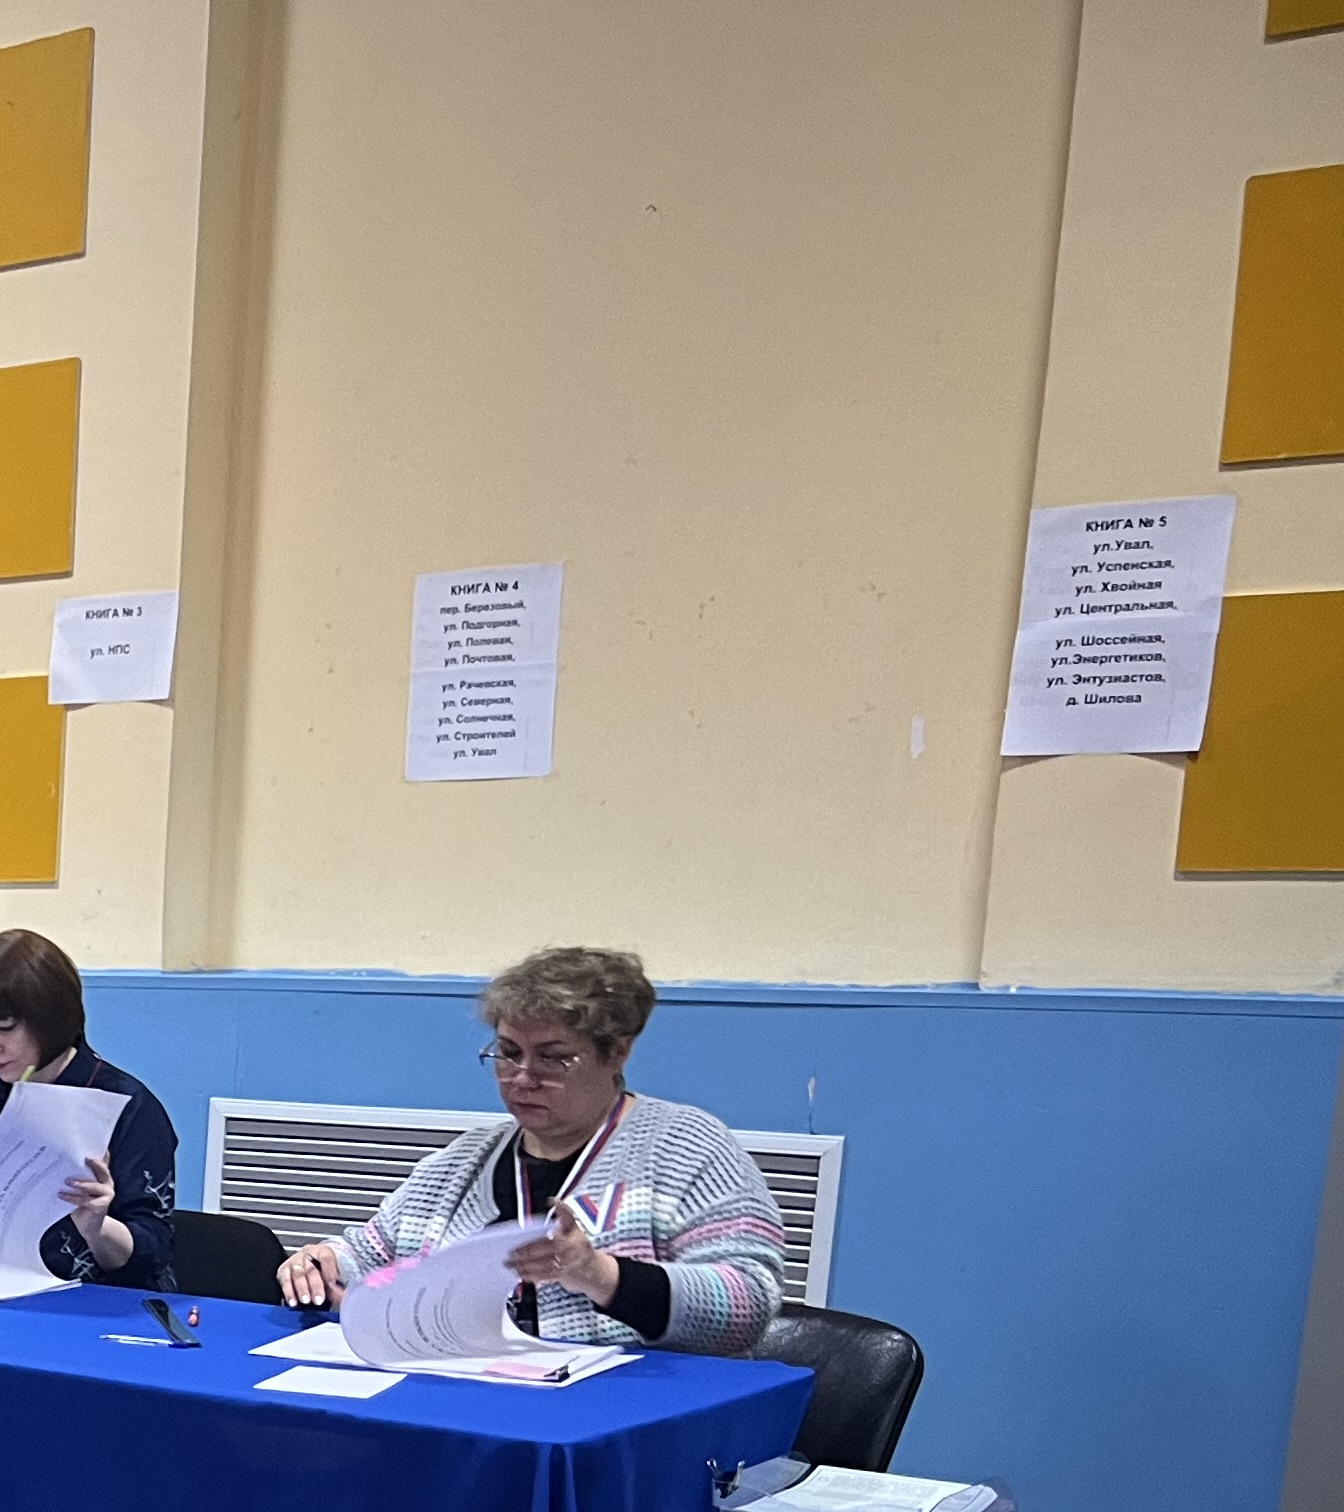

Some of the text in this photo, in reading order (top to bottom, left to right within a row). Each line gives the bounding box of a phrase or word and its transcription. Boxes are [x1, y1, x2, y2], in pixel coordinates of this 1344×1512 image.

[1085, 516, 1167, 532] КНИГА № 5
[1071, 559, 1174, 577] ул. Успенская,
[451, 581, 518, 595] КНИГА № 4
[1075, 580, 1161, 597] ул. Хвойная
[86, 606, 142, 620] КНИГА № 3
[440, 606, 460, 615] пер.
[1055, 600, 1177, 618] ул. Центральная,
[443, 623, 458, 633] ул.
[447, 640, 462, 649] ул.
[1055, 634, 1165, 650] ул. Шоссейная,
[108, 644, 130, 655] НПС
[444, 657, 459, 667] ул.
[1046, 673, 1166, 688] ул. Энтузиастов,
[441, 683, 456, 693] ул.
[442, 700, 457, 710] ул.
[1066, 694, 1141, 707] д. Шилова
[438, 717, 453, 727] ул.
[436, 728, 515, 743] ул. Строителей
[453, 750, 468, 759] ул.
